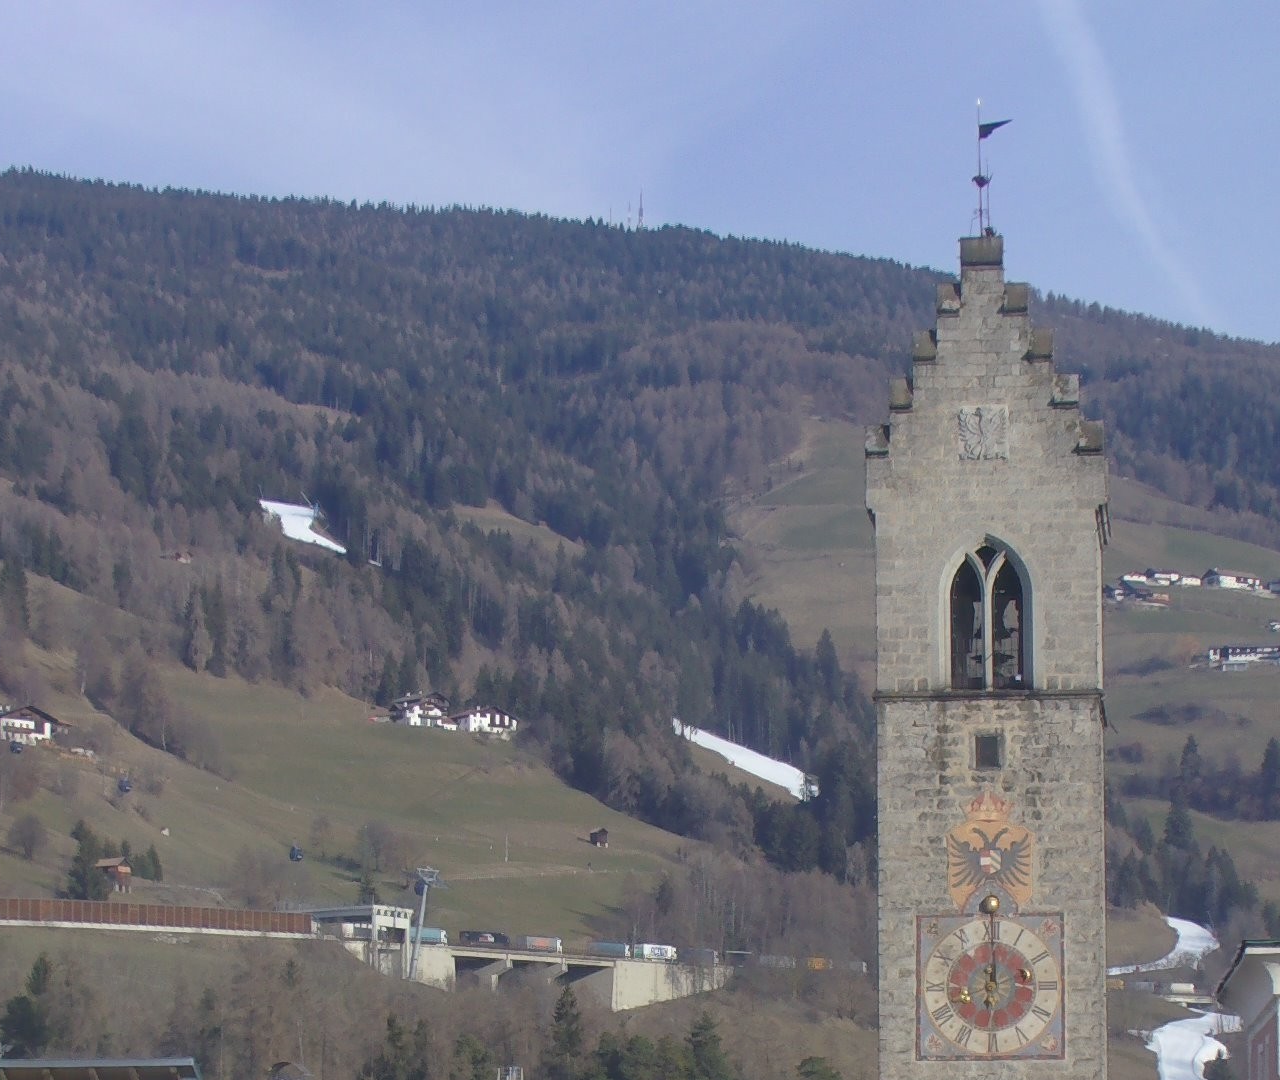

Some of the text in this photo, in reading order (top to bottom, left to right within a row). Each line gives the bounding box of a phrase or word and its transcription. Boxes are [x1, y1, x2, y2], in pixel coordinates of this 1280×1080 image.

[953, 928, 969, 949] XI
[1014, 929, 1024, 946] I
[933, 949, 953, 967] X
[1031, 951, 1050, 965] II
[925, 980, 945, 992] IX
[1038, 981, 1058, 991] III
[987, 1033, 999, 1052] VI
[1015, 1026, 1029, 1045] V
